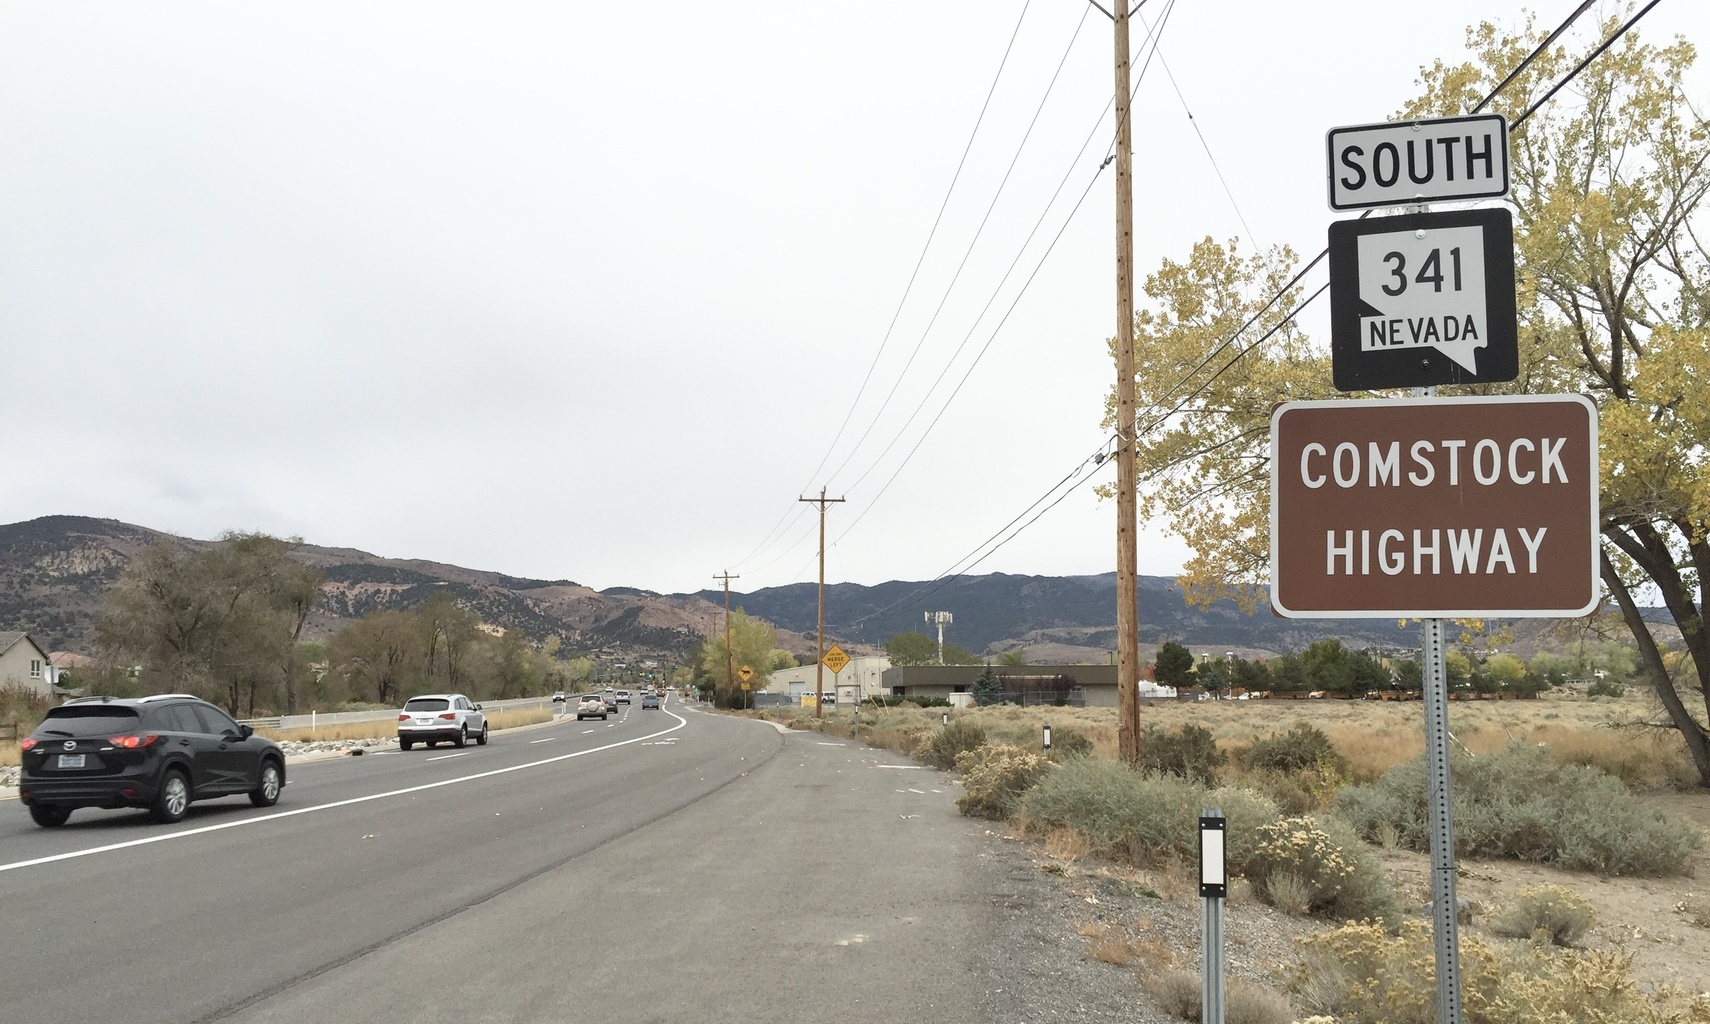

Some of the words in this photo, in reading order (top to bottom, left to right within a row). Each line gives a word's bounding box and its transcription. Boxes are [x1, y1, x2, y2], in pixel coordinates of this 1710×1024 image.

[1341, 134, 1494, 190] SOUTH
[1382, 247, 1462, 296] 341
[1370, 315, 1479, 346] NEVADA
[1300, 437, 1569, 488] COMSTOCK
[1326, 528, 1548, 576] HIGHWAY
